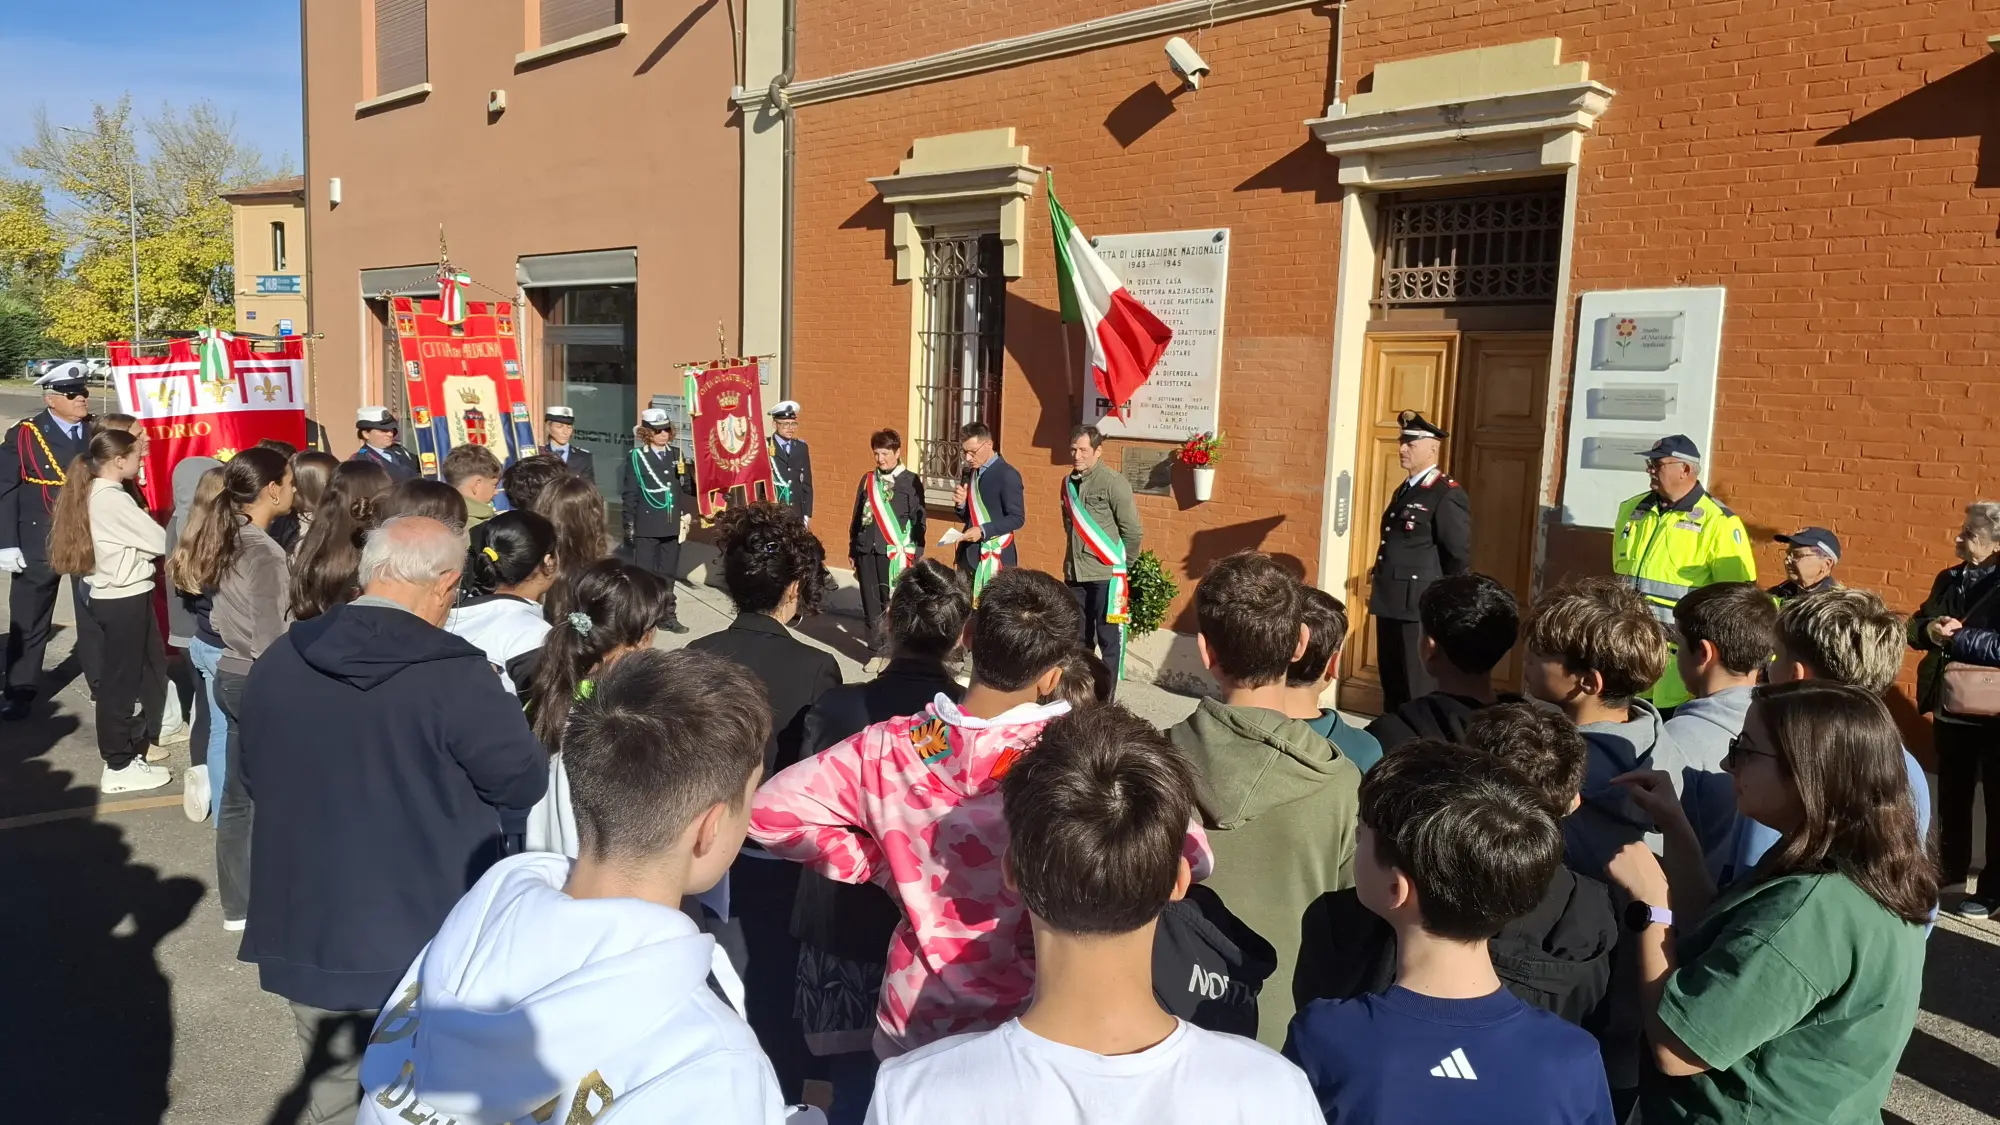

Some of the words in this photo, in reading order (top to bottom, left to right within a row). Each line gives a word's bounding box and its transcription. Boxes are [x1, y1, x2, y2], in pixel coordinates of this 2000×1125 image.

[1120, 250, 1127, 259] DI
[1130, 247, 1178, 259] LIBERAZIONE
[1181, 245, 1223, 256] NAZIONALE
[143, 420, 212, 440] UDRIO
